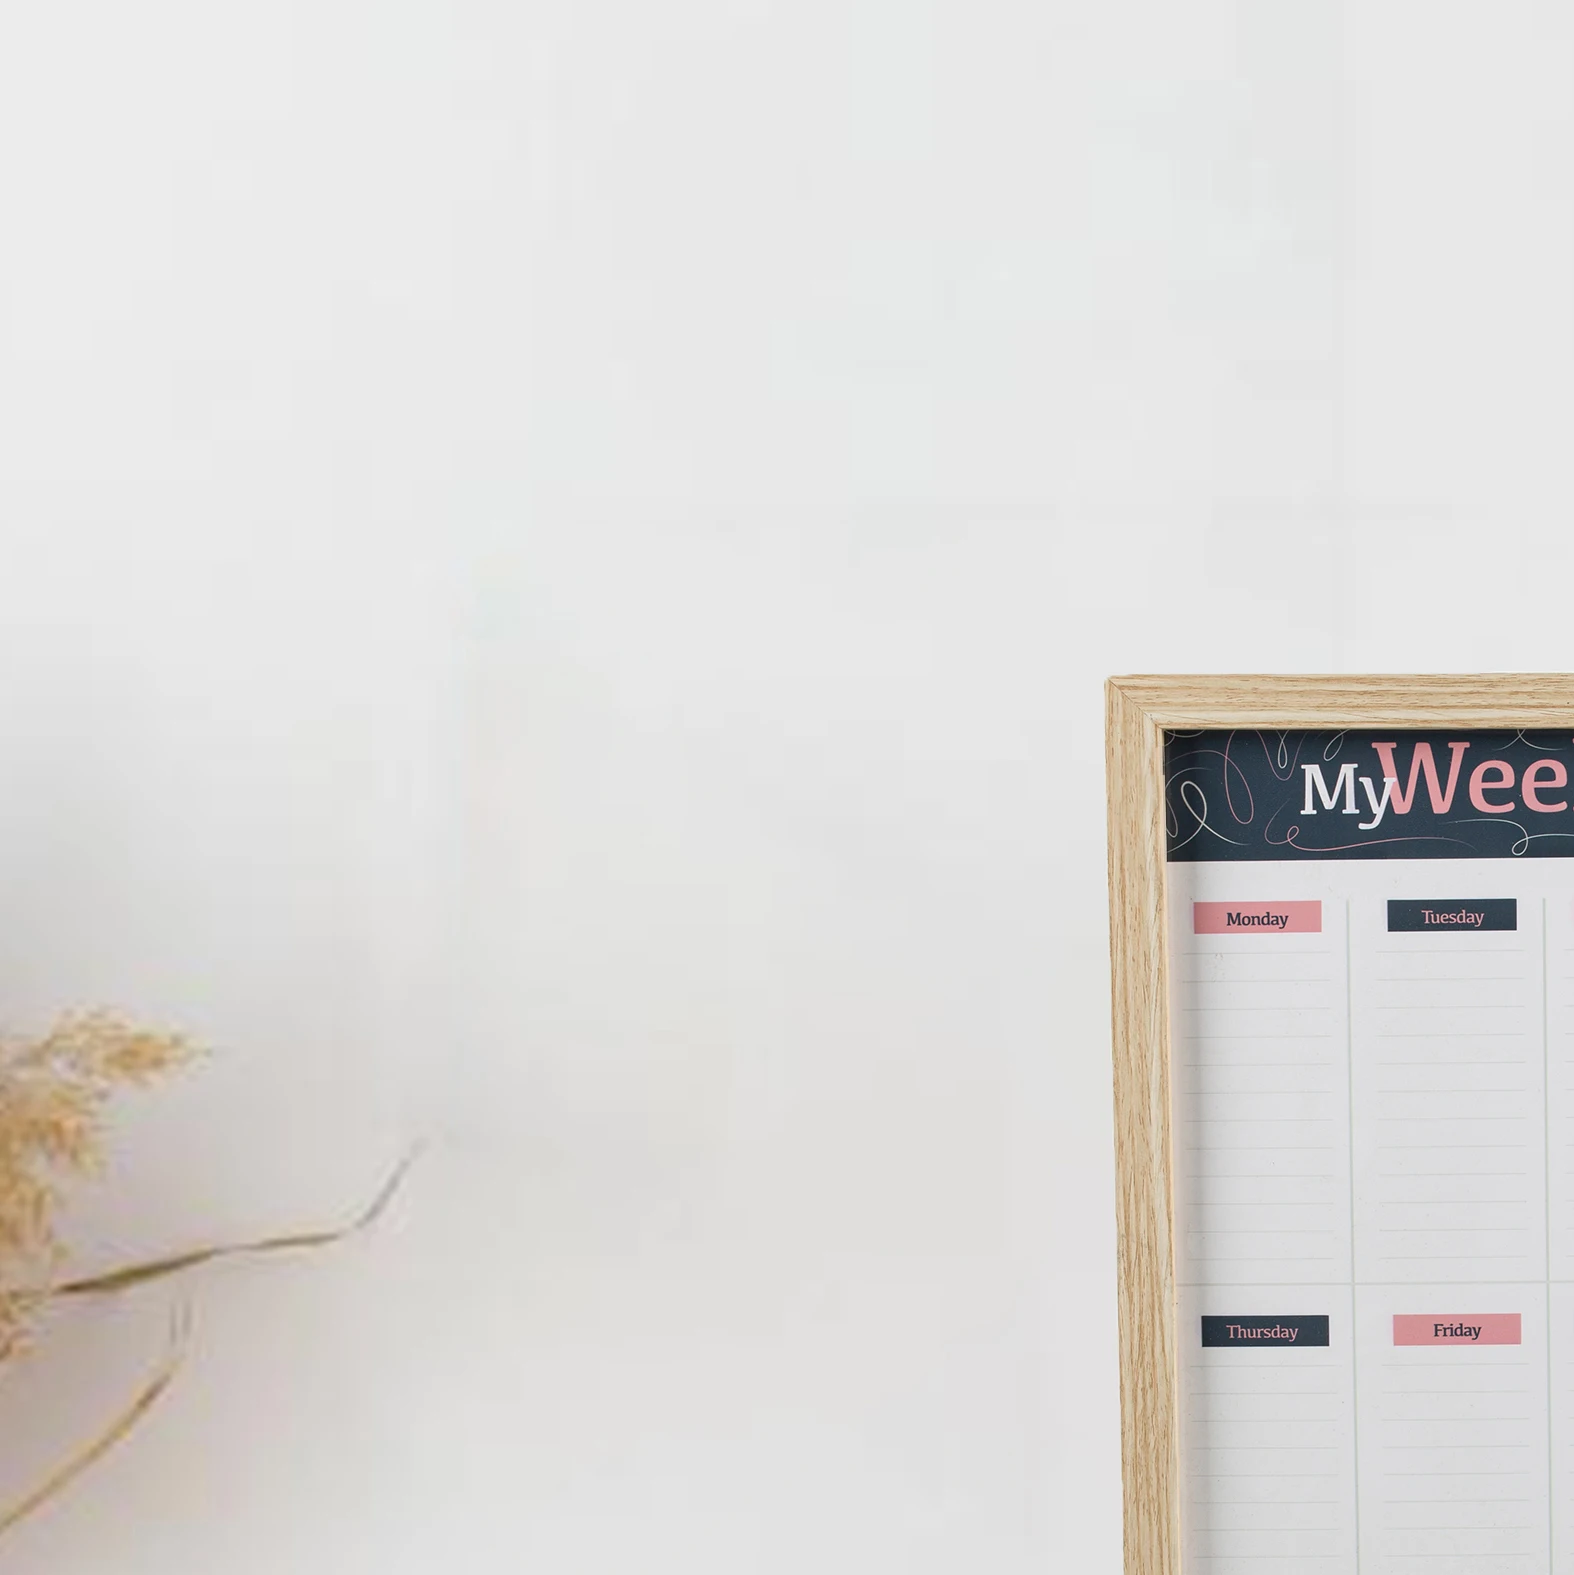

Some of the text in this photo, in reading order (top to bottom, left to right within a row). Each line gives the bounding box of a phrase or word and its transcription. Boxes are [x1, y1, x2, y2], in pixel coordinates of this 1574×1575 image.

[1300, 763, 1397, 830] My
[1226, 912, 1289, 929] Monday
[1421, 909, 1485, 927] Tuesday
[1226, 1324, 1299, 1342] Thursday
[1433, 1323, 1482, 1340] Friday
